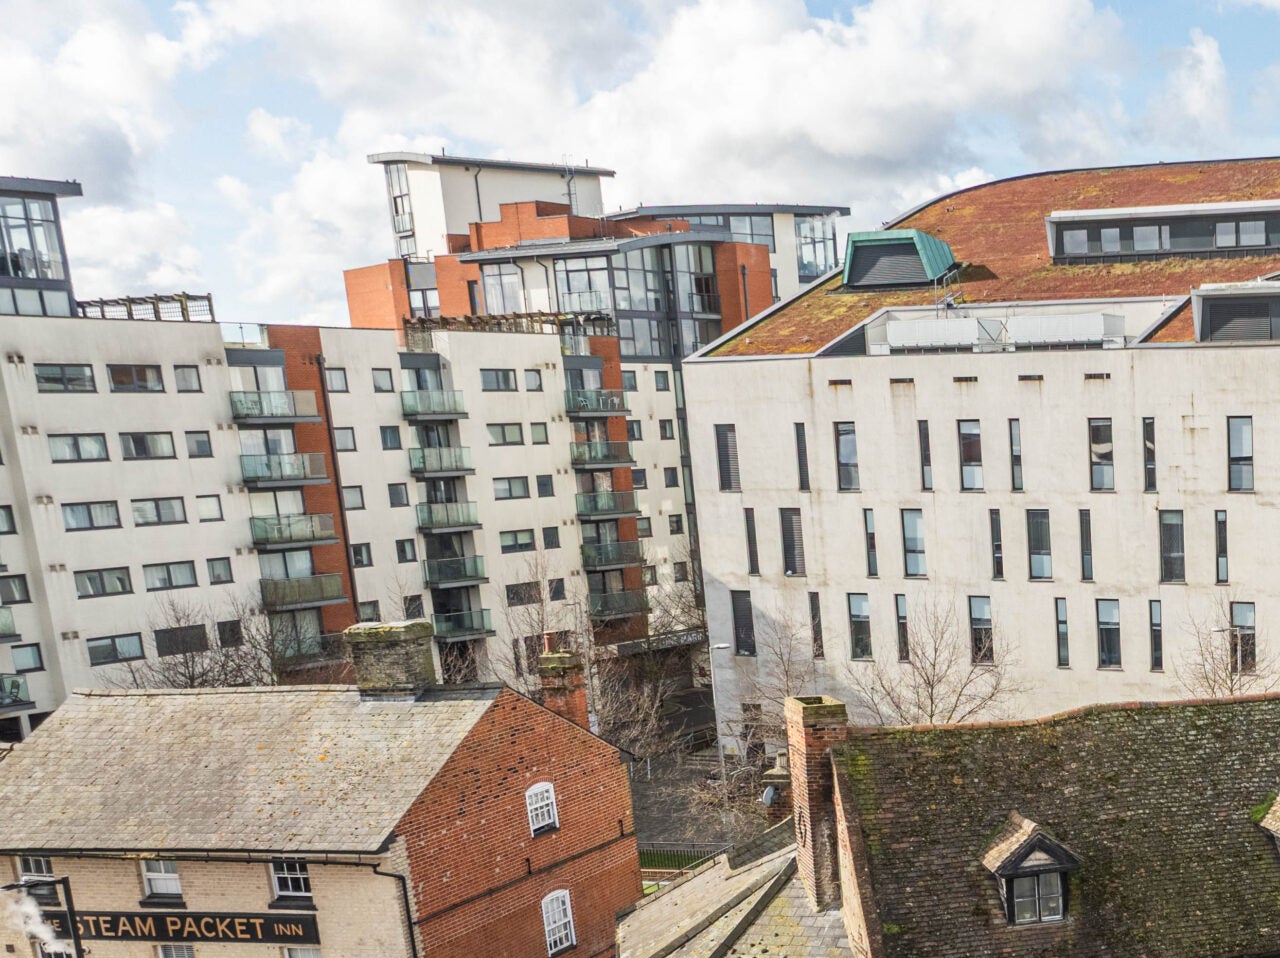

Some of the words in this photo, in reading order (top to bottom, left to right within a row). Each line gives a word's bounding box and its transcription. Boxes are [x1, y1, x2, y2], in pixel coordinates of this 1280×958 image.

[76, 915, 156, 937] STEAM
[165, 916, 265, 939] PACKET
[273, 922, 304, 937] INN
